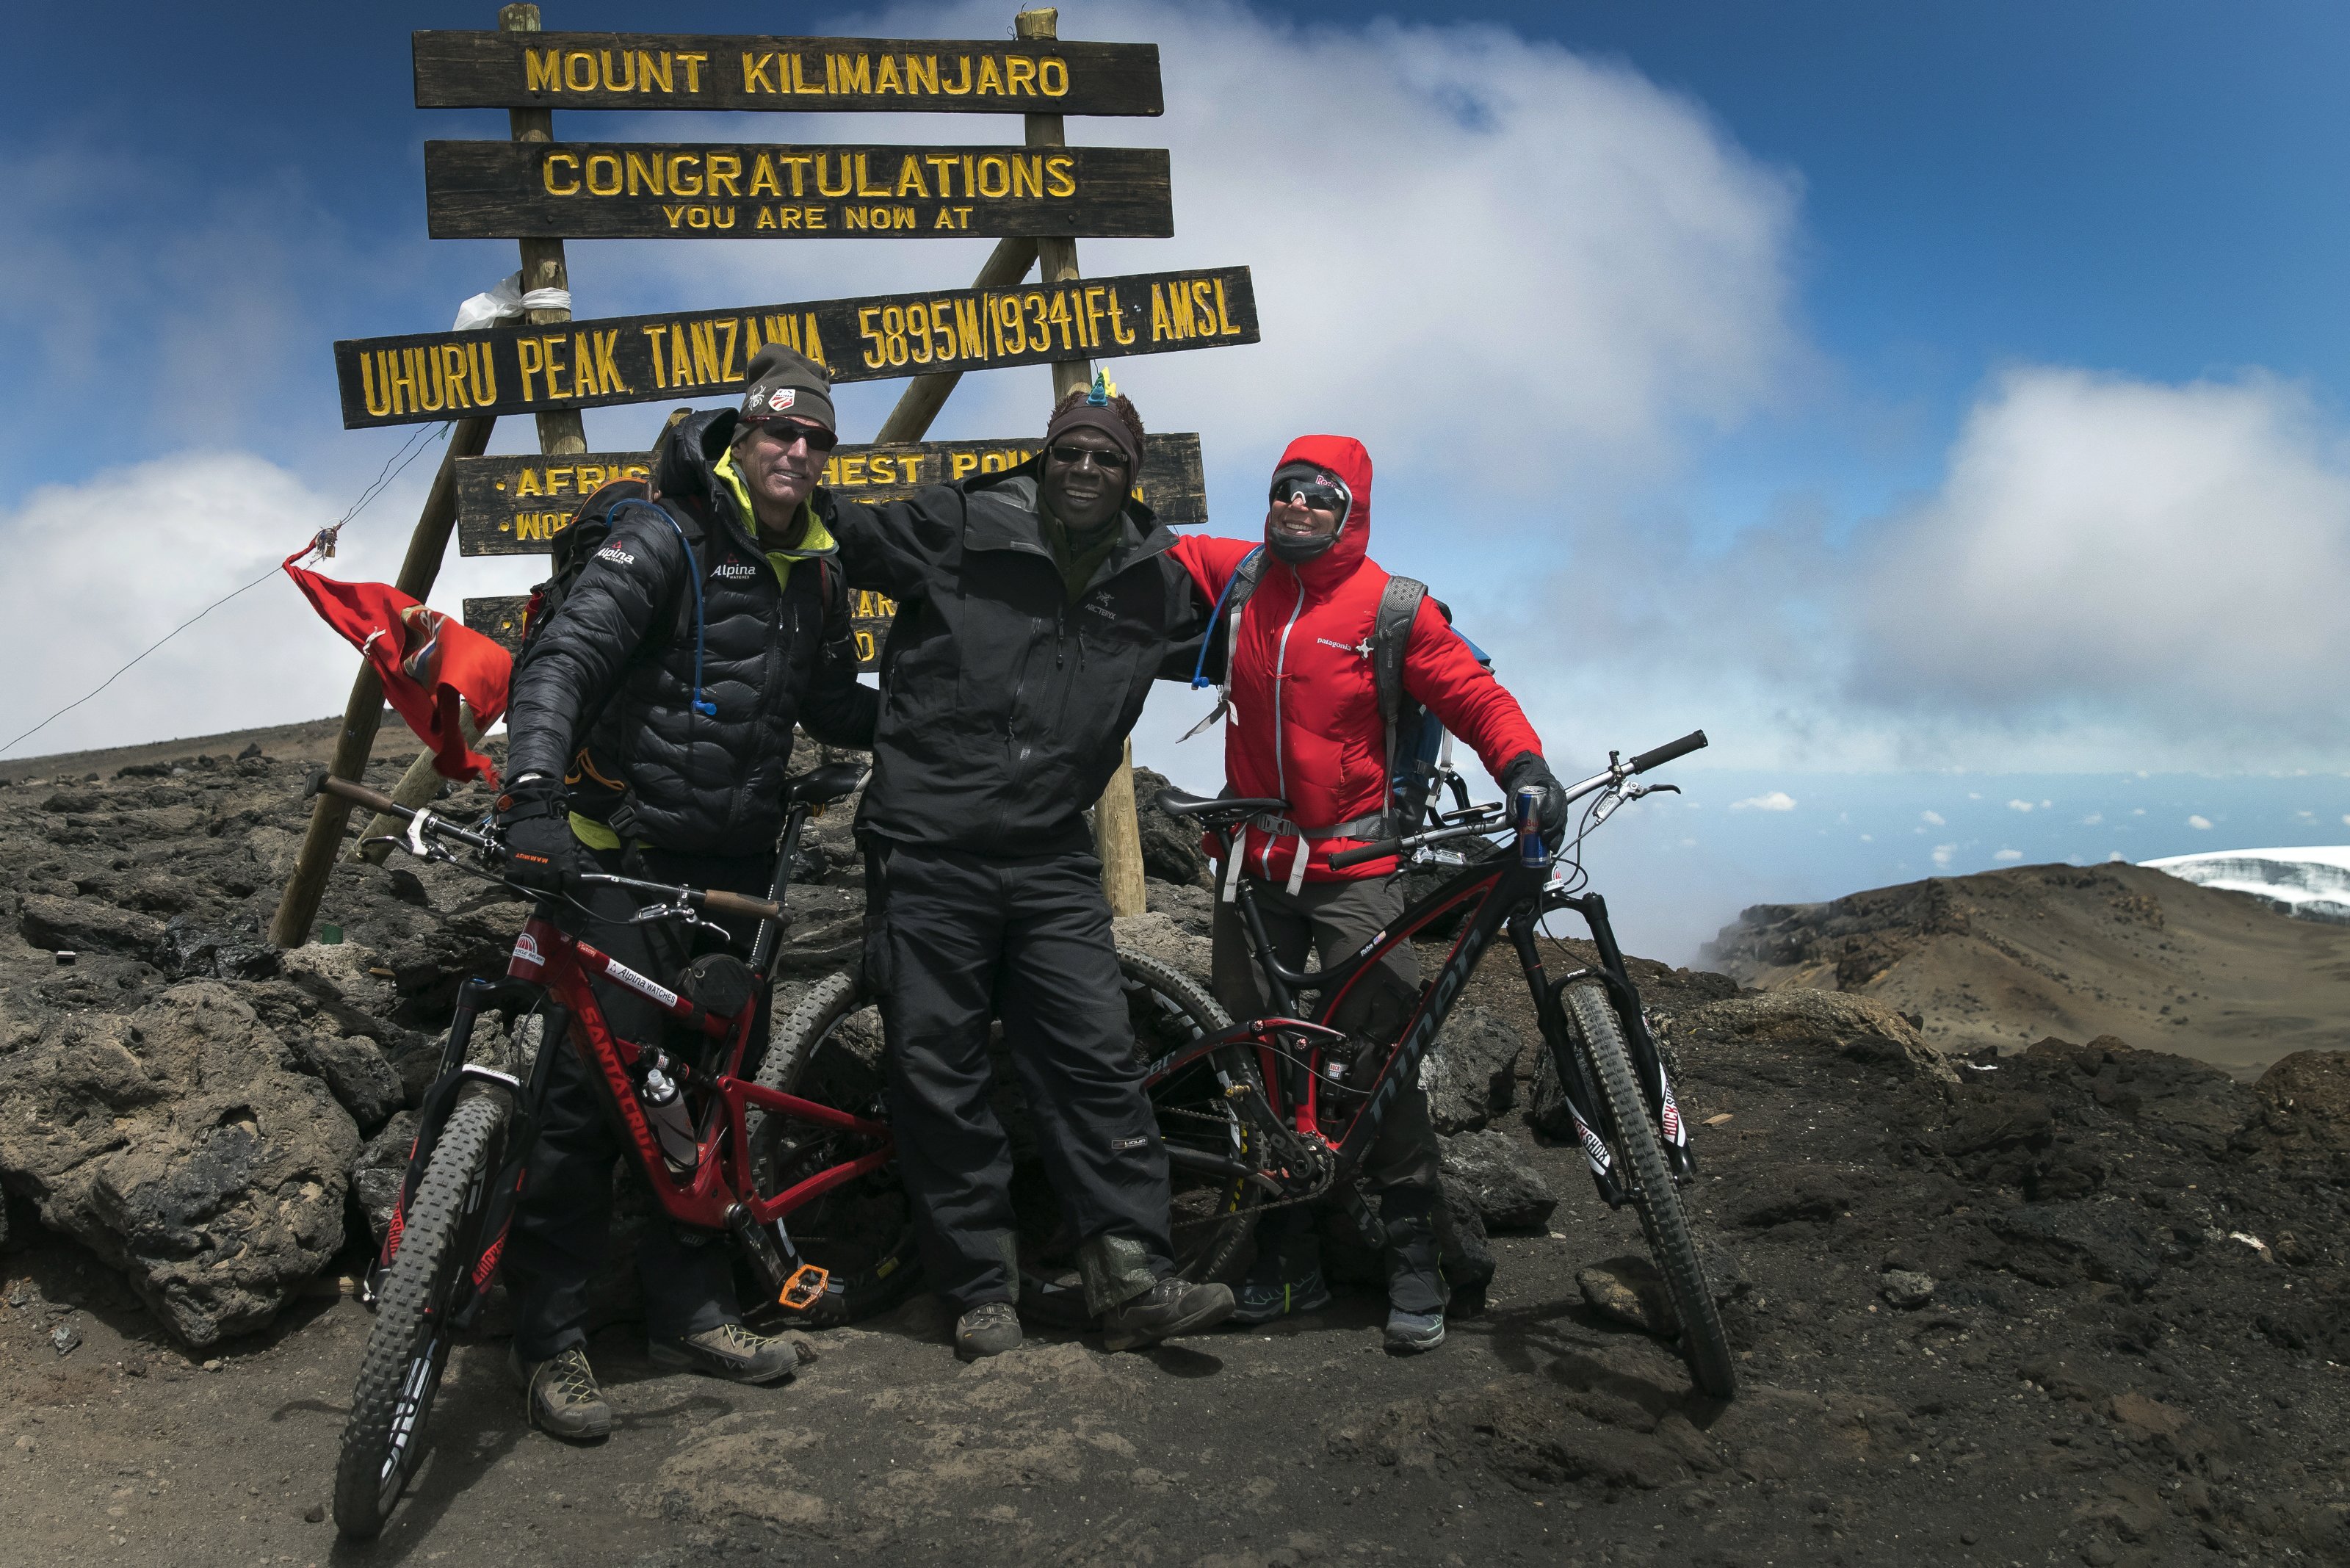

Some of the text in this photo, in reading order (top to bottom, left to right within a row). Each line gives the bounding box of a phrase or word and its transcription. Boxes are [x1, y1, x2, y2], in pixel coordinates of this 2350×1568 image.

[524, 48, 1070, 97] MOUNT KILIMANJARO
[543, 151, 1077, 198] CONGRATULATIONS
[662, 206, 975, 230] YOU ARE NOW AT
[360, 342, 497, 416] UHURU
[858, 286, 1135, 369] 5895M/19341Ft
[1151, 277, 1241, 342] AMSL
[817, 452, 925, 486] HEST
[594, 547, 634, 565] Alpina
[709, 564, 756, 578] Alpina
[1317, 637, 1352, 651] patagonia
[516, 853, 549, 864] MAMMUT
[618, 968, 676, 1004] Alpina WATCHES
[579, 1006, 659, 1163] SANTA CRUZ
